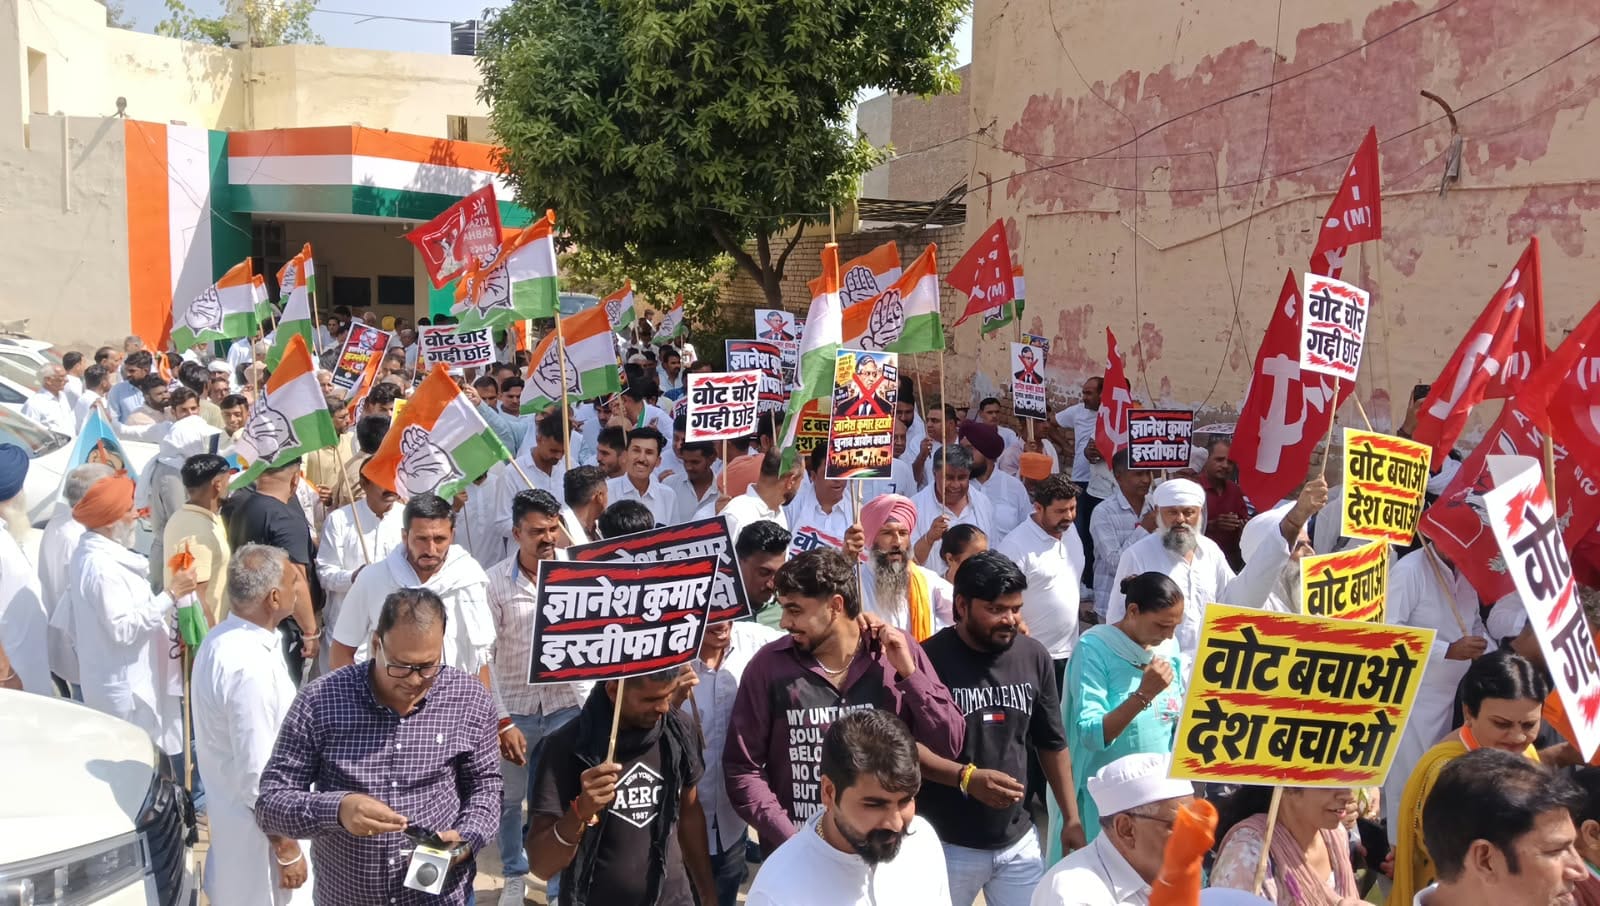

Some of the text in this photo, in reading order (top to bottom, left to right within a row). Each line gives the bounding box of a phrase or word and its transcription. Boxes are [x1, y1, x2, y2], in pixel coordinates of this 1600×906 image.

[1309, 288, 1343, 323] वोट
[1344, 297, 1365, 334] चोर
[424, 331, 455, 347] वोट
[1307, 328, 1342, 362] गद्दी
[427, 345, 491, 363] गद्दी छोड़
[693, 382, 729, 405] वोट
[732, 379, 758, 402] चोर
[691, 406, 731, 430] गद्दी
[857, 418, 874, 434] कुमार
[1130, 416, 1193, 440] ज्ञानेश कुमार
[1131, 440, 1190, 461] इस्तीफा दो
[1349, 442, 1427, 493] वोट बचाओ
[1348, 486, 1422, 533] देश बचाओ
[1512, 504, 1572, 602] वोट
[1307, 551, 1386, 616] वोट बचाओ
[542, 576, 713, 624] ज्ञानेश कुमार
[540, 613, 700, 671] इस्तीफा दो
[1202, 626, 1418, 705] वोट बचाओ
[953, 683, 1033, 717] TOMMY JEANS
[787, 709, 805, 726] MY
[789, 727, 824, 745] SOUL
[1187, 698, 1397, 768] देश बचाओ
[789, 746, 822, 762] BELO
[624, 771, 655, 786] NEW YORK
[791, 764, 810, 780] NO
[793, 783, 818, 800] BUT
